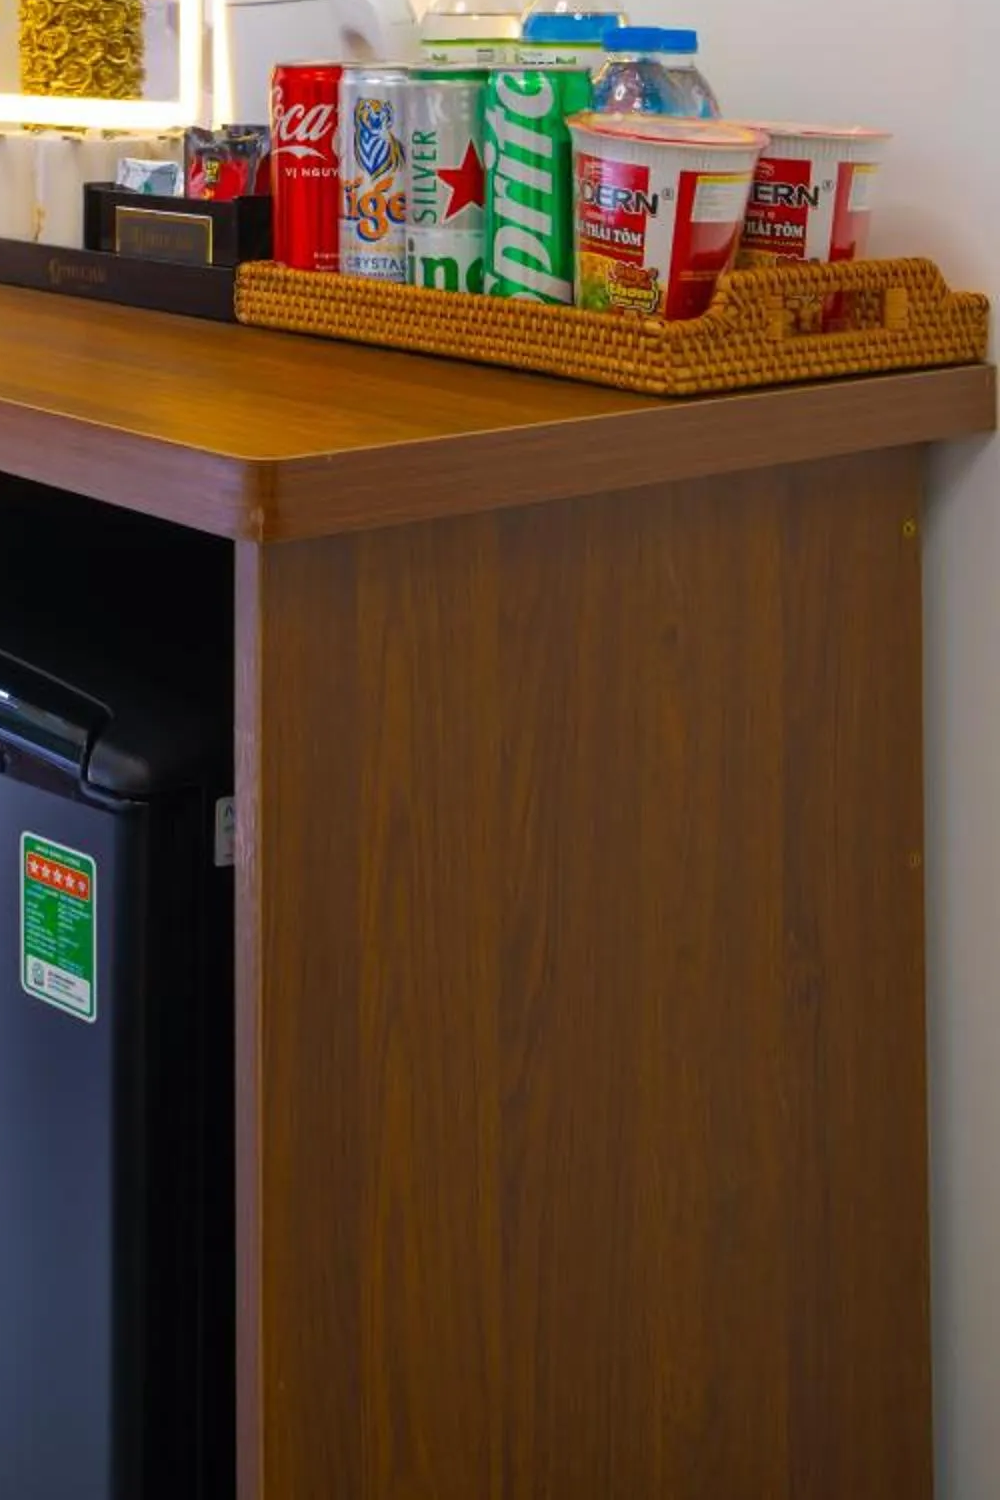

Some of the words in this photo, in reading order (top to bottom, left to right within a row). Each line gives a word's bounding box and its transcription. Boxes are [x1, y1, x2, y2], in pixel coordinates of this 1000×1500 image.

[301, 167, 339, 177] NGUY
[411, 130, 437, 224] SILVER
[752, 183, 819, 208] ERN
